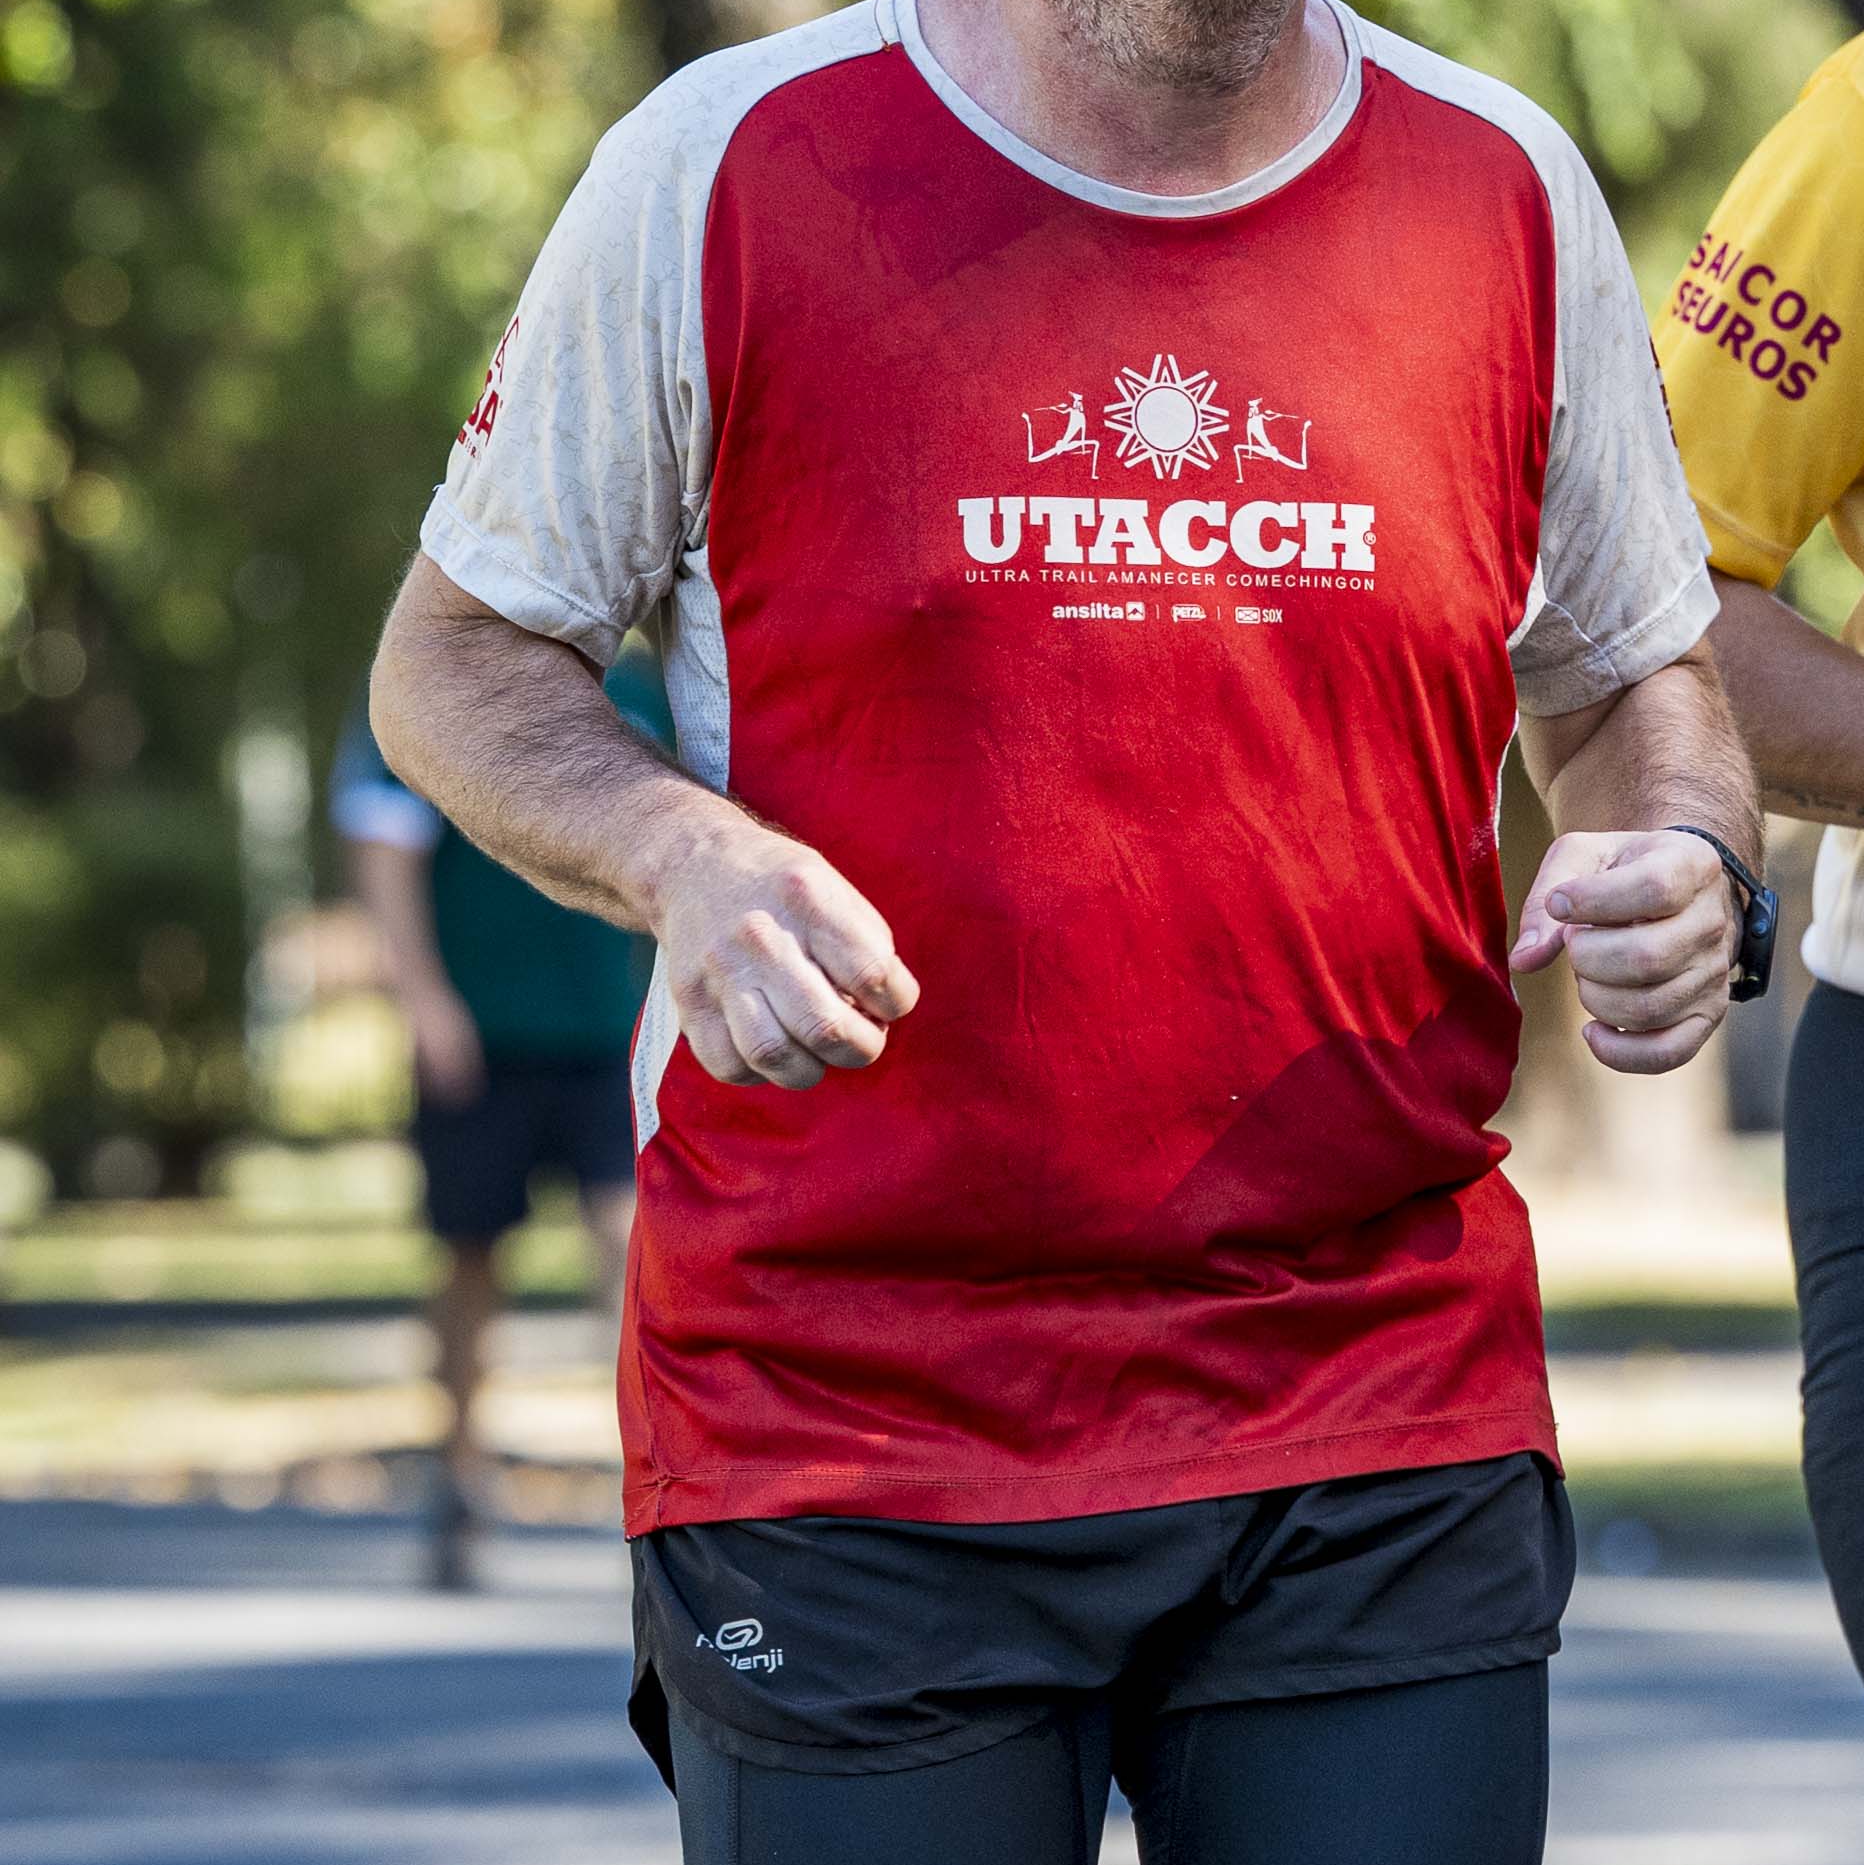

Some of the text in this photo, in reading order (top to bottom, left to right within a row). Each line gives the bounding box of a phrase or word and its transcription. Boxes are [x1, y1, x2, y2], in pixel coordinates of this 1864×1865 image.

[965, 569, 1376, 592] ULTRA TRAIL AMANECER COMECHINGON
[1052, 602, 1124, 620] ansilta
